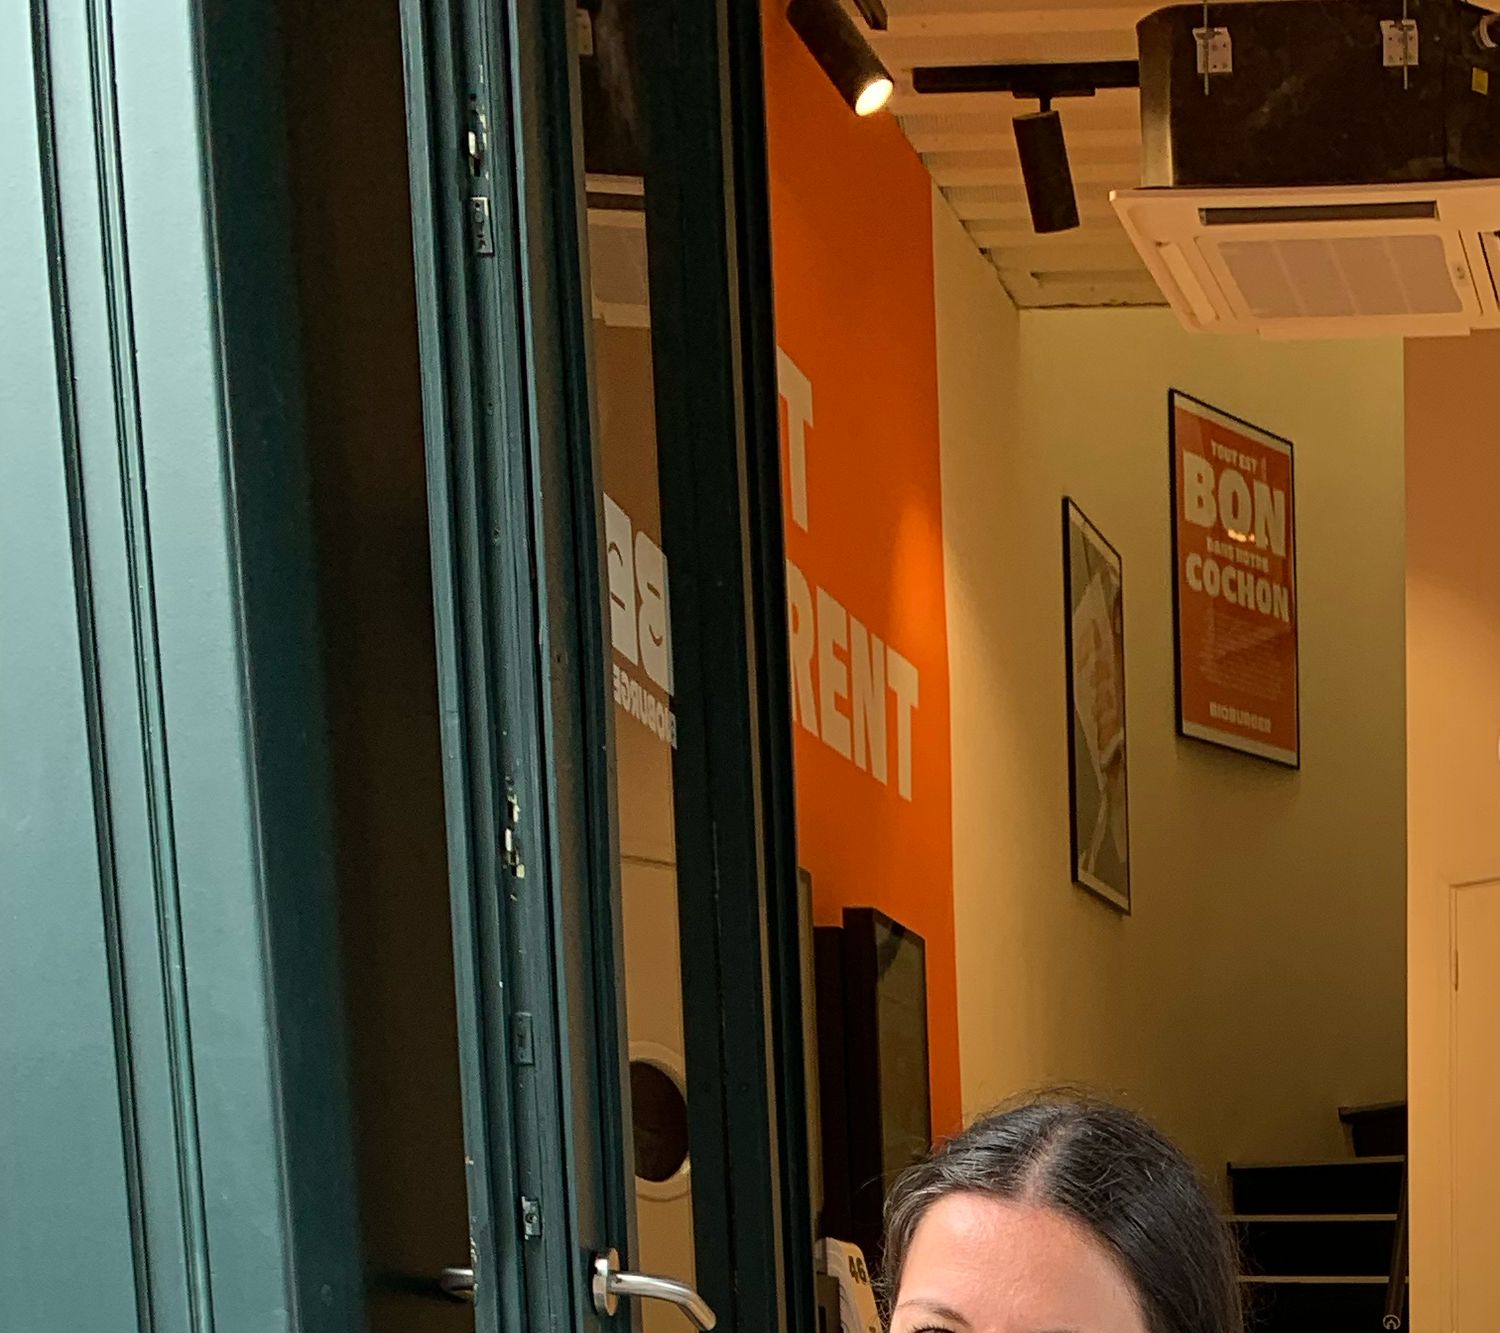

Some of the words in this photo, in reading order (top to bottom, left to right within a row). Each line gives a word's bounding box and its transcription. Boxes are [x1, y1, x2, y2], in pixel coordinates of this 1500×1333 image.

[1211, 440, 1237, 467] TOUT
[1183, 449, 1286, 557] BON
[1186, 553, 1289, 622] COCHON
[1209, 701, 1272, 733] BIOBURGER
